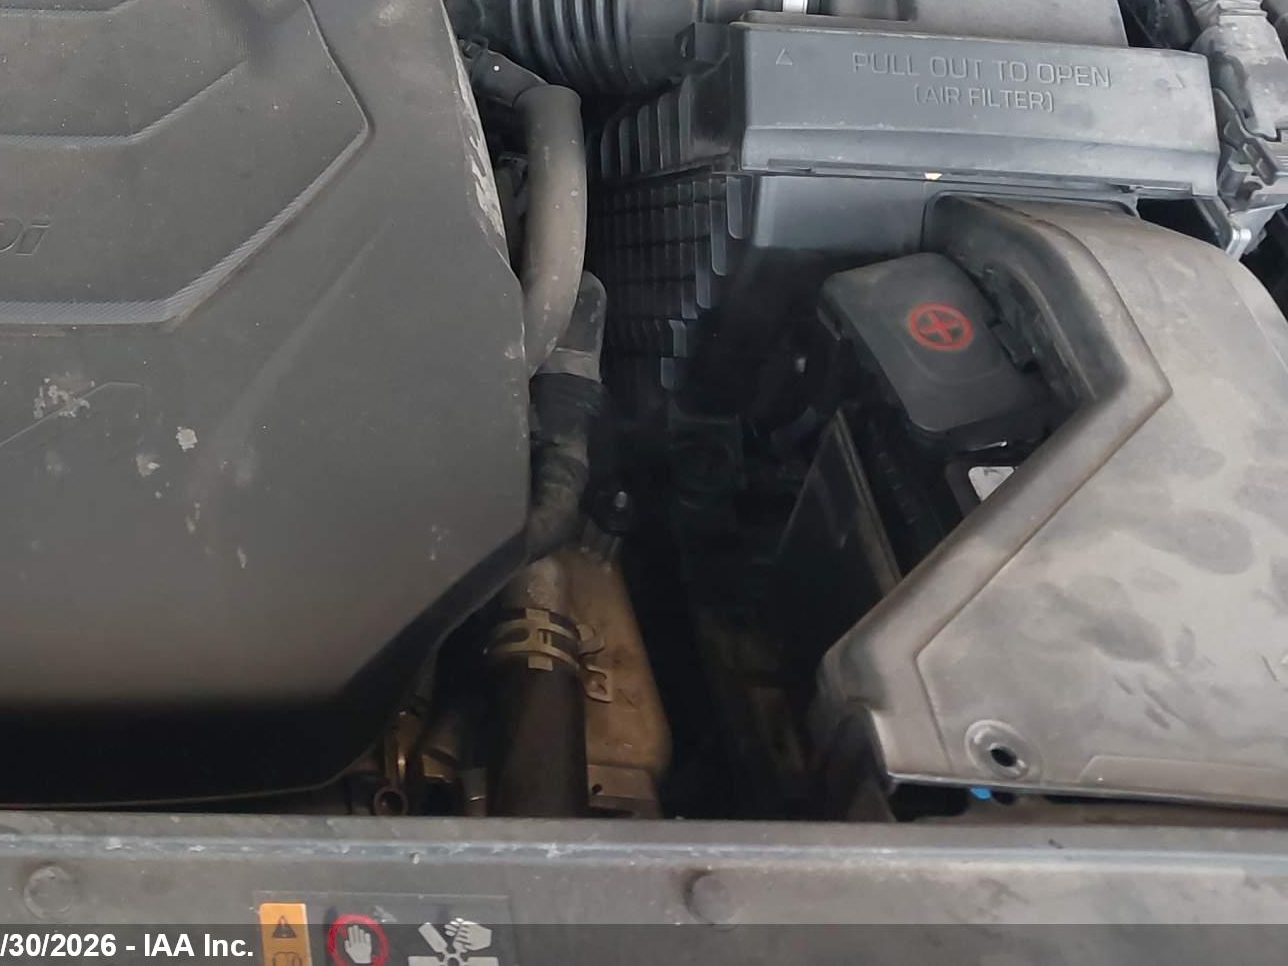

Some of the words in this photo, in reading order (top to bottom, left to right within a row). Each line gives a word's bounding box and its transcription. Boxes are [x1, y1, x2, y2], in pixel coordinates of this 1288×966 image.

[852, 52, 920, 77] PULL
[929, 57, 982, 80] OUT
[992, 60, 1029, 83] TO
[1037, 63, 1112, 88] OPEN
[968, 87, 1054, 113] FILTER)
